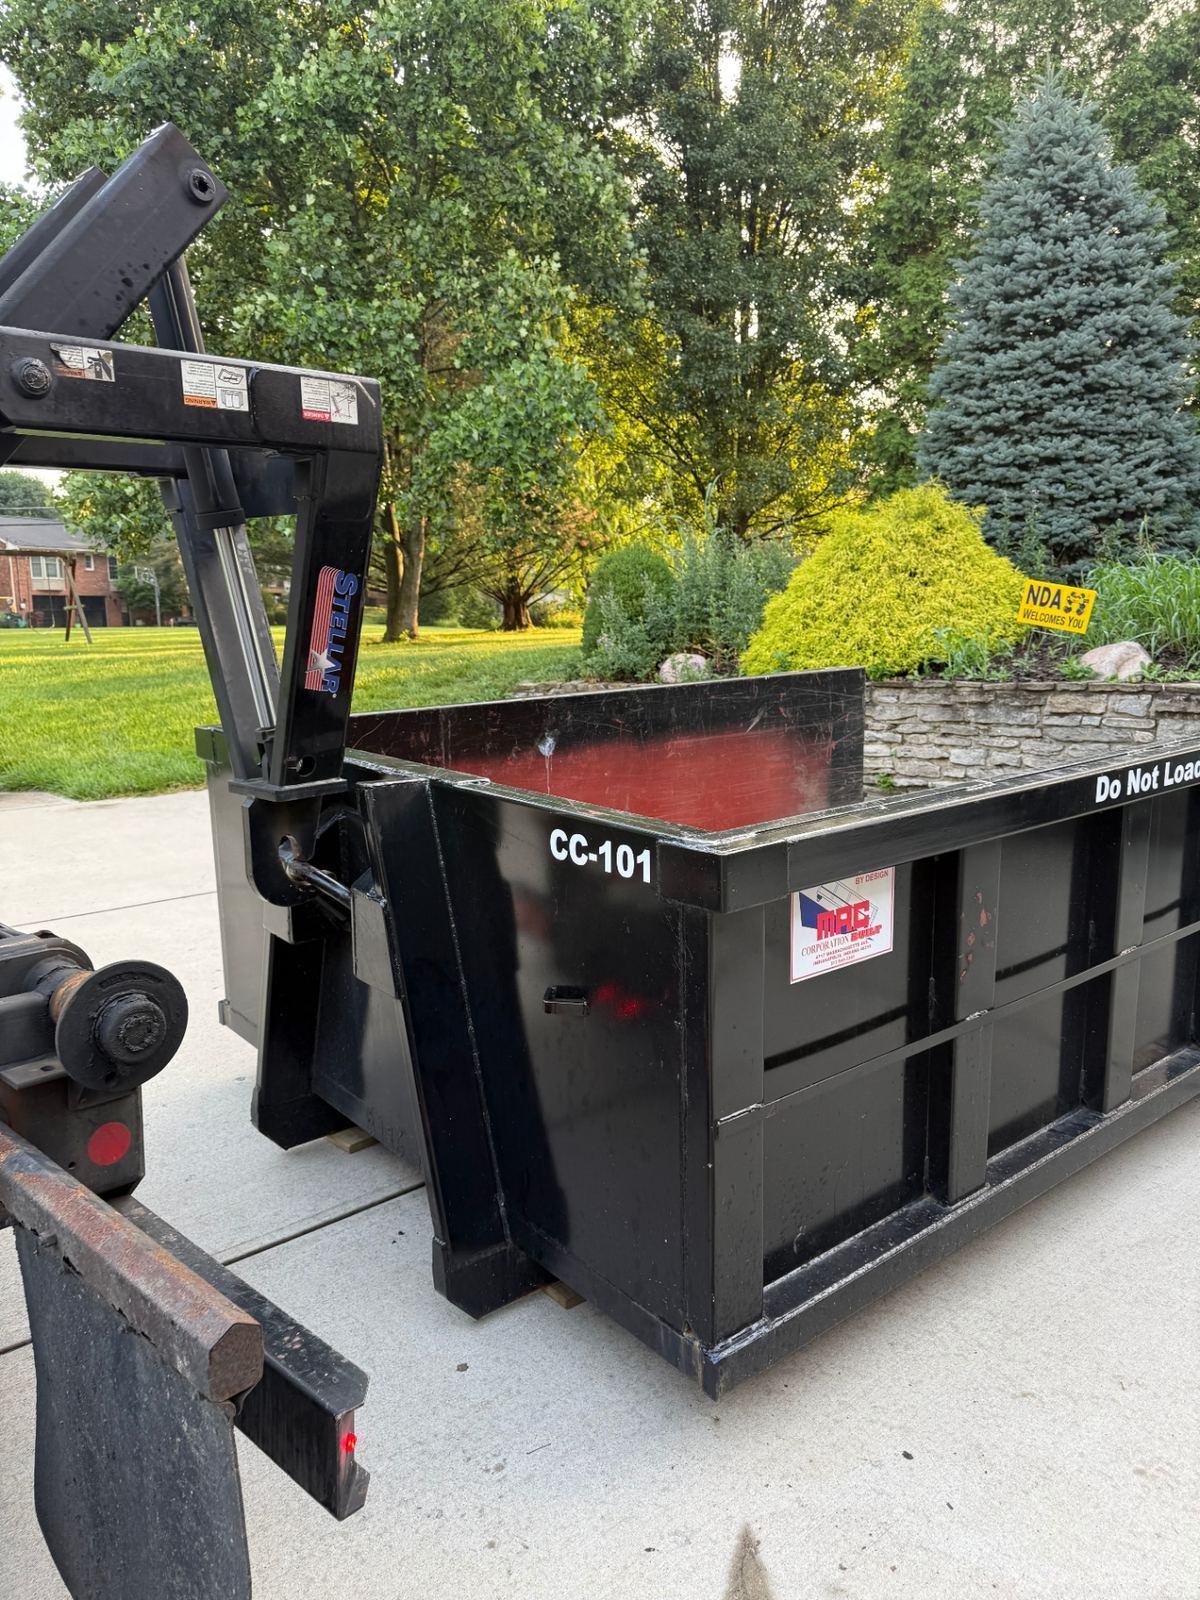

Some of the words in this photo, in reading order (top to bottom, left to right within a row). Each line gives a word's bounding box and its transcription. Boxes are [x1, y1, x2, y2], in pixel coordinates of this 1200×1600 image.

[1026, 584, 1062, 610] NDA
[1023, 608, 1066, 626] WELCOMES
[1068, 616, 1084, 629] YOU
[321, 570, 359, 694] STELLAR
[1095, 775, 1122, 803] Do
[1126, 765, 1160, 796] Not
[550, 828, 651, 884] CC-101
[855, 877, 865, 885] BY
[865, 870, 889, 882] DESIGN
[801, 936, 849, 957] CORPORATION
